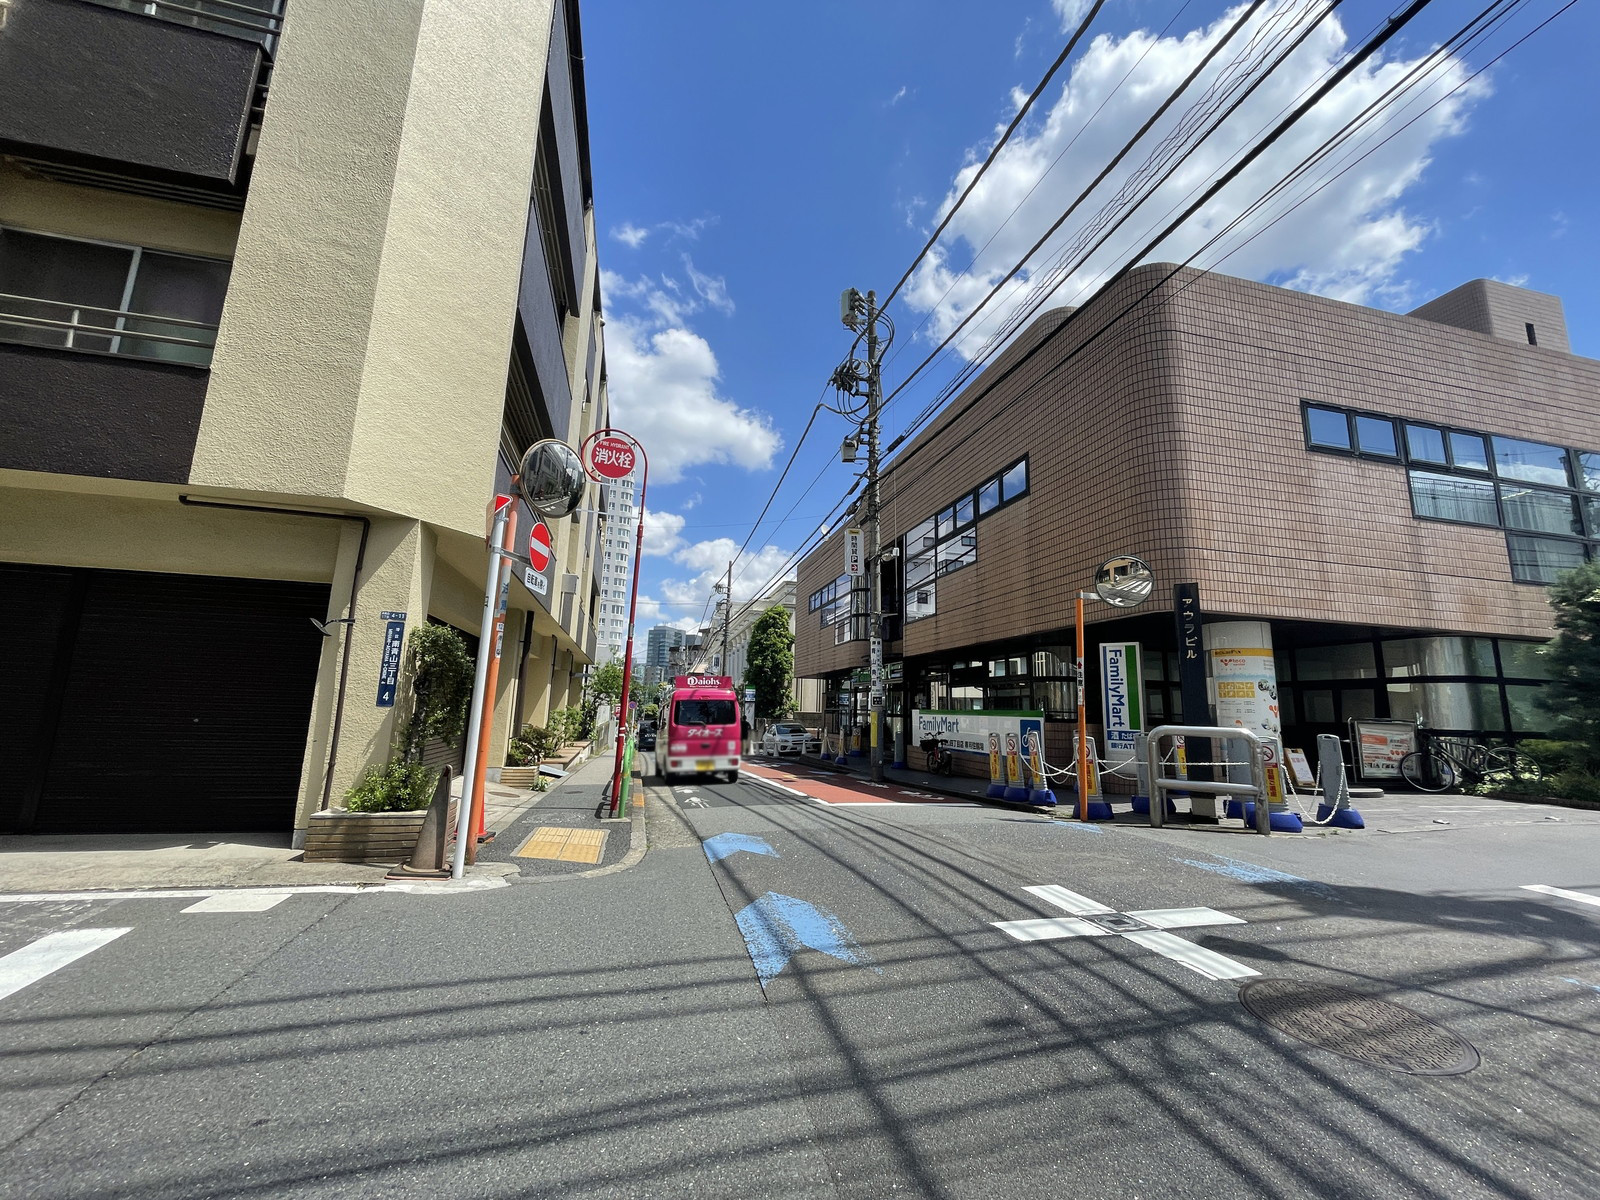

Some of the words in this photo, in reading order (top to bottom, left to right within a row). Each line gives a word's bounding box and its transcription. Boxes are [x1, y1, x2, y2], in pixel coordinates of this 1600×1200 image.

[594, 447, 632, 468] 消火栓
[1182, 598, 1198, 659] アウラビル
[387, 640, 400, 685] 南青山三丁目
[382, 691, 390, 701] 4
[1108, 649, 1126, 727] FamilyMart
[919, 716, 959, 733] FamilyMart
